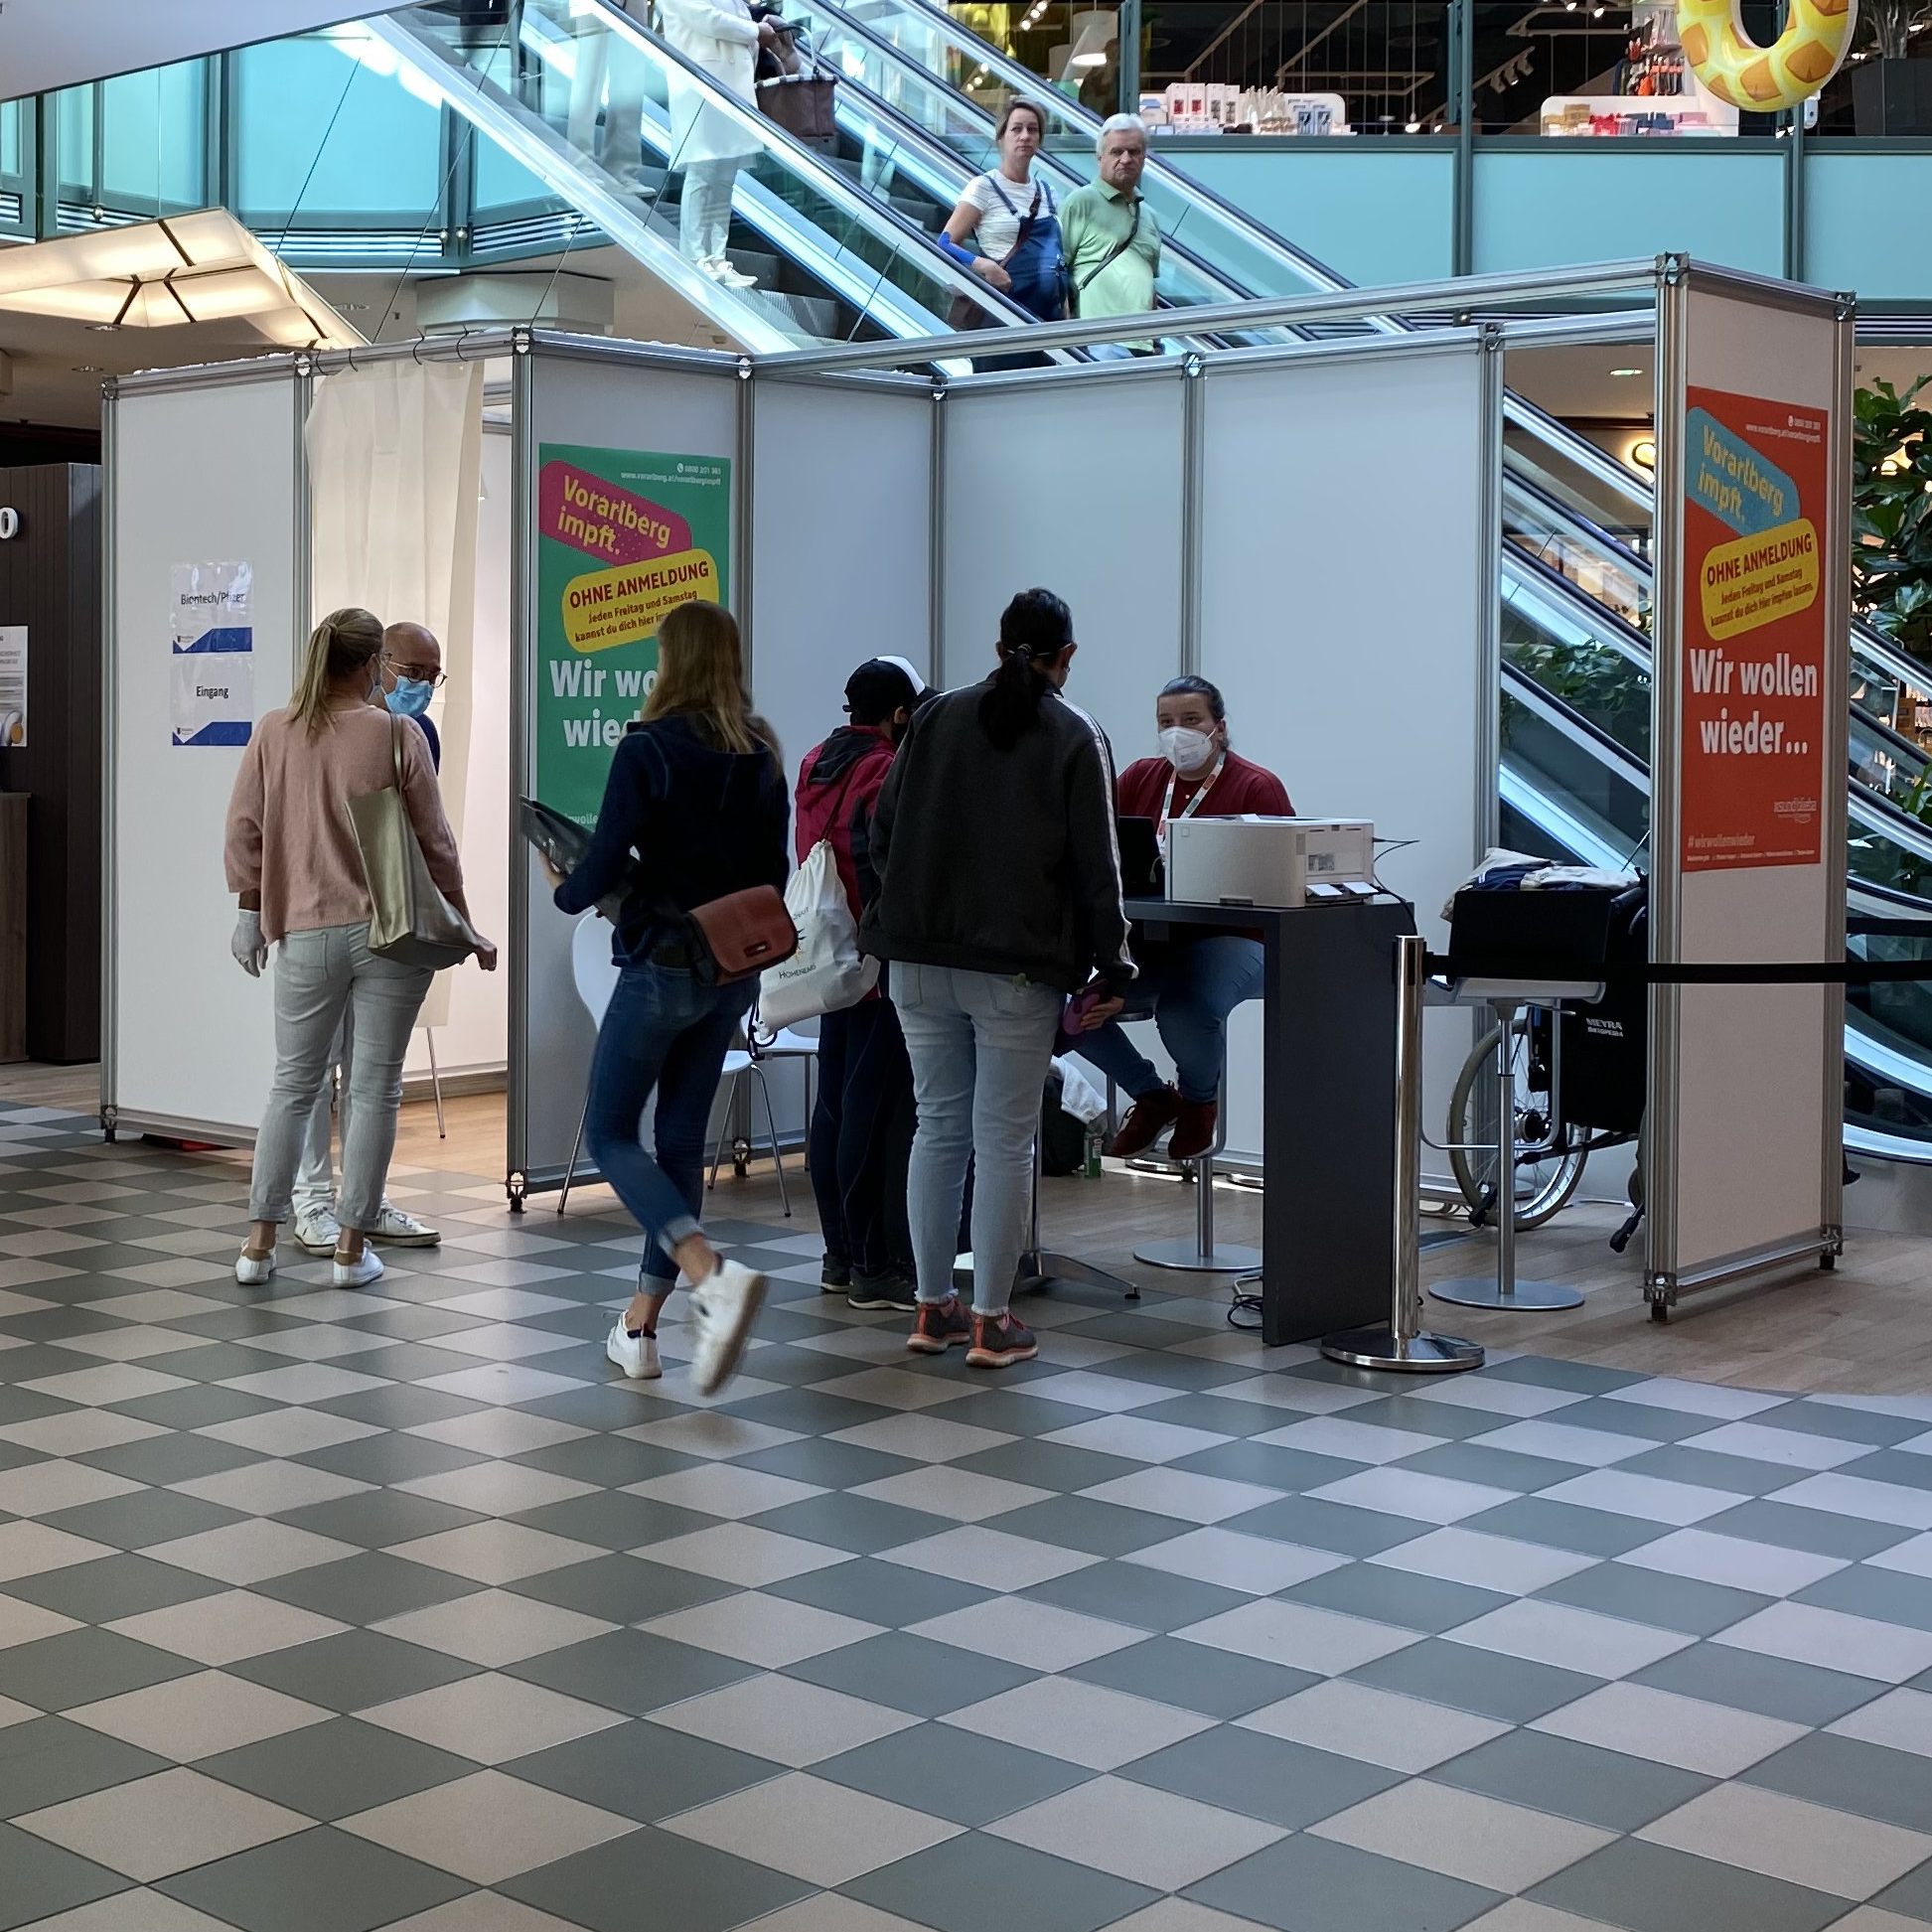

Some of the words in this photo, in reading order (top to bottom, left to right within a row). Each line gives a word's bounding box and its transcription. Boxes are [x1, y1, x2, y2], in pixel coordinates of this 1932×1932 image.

[1699, 462, 1745, 524] impft.
[1704, 424, 1784, 518] Vorarlberg
[557, 505, 621, 555] impft.
[564, 475, 671, 549] Vorarlberg
[569, 584, 613, 608] OHNE
[617, 560, 709, 597] ANMELDUNG
[1707, 557, 1741, 588] OHNE
[1743, 532, 1813, 574] ANMELDUNG
[575, 627, 605, 642] kannst
[606, 624, 617, 636] du
[619, 620, 638, 632] dich
[638, 615, 655, 627] hier
[588, 609, 613, 624] Jeden
[614, 604, 645, 617] Freitag
[646, 598, 662, 610] und
[663, 590, 697, 605] Samstag
[196, 685, 229, 699] Eingang
[549, 659, 607, 697] Wir
[615, 669, 660, 697] wo
[1690, 647, 1734, 693] Wir
[1740, 653, 1817, 696] wollen
[1700, 707, 1808, 755] wieder...
